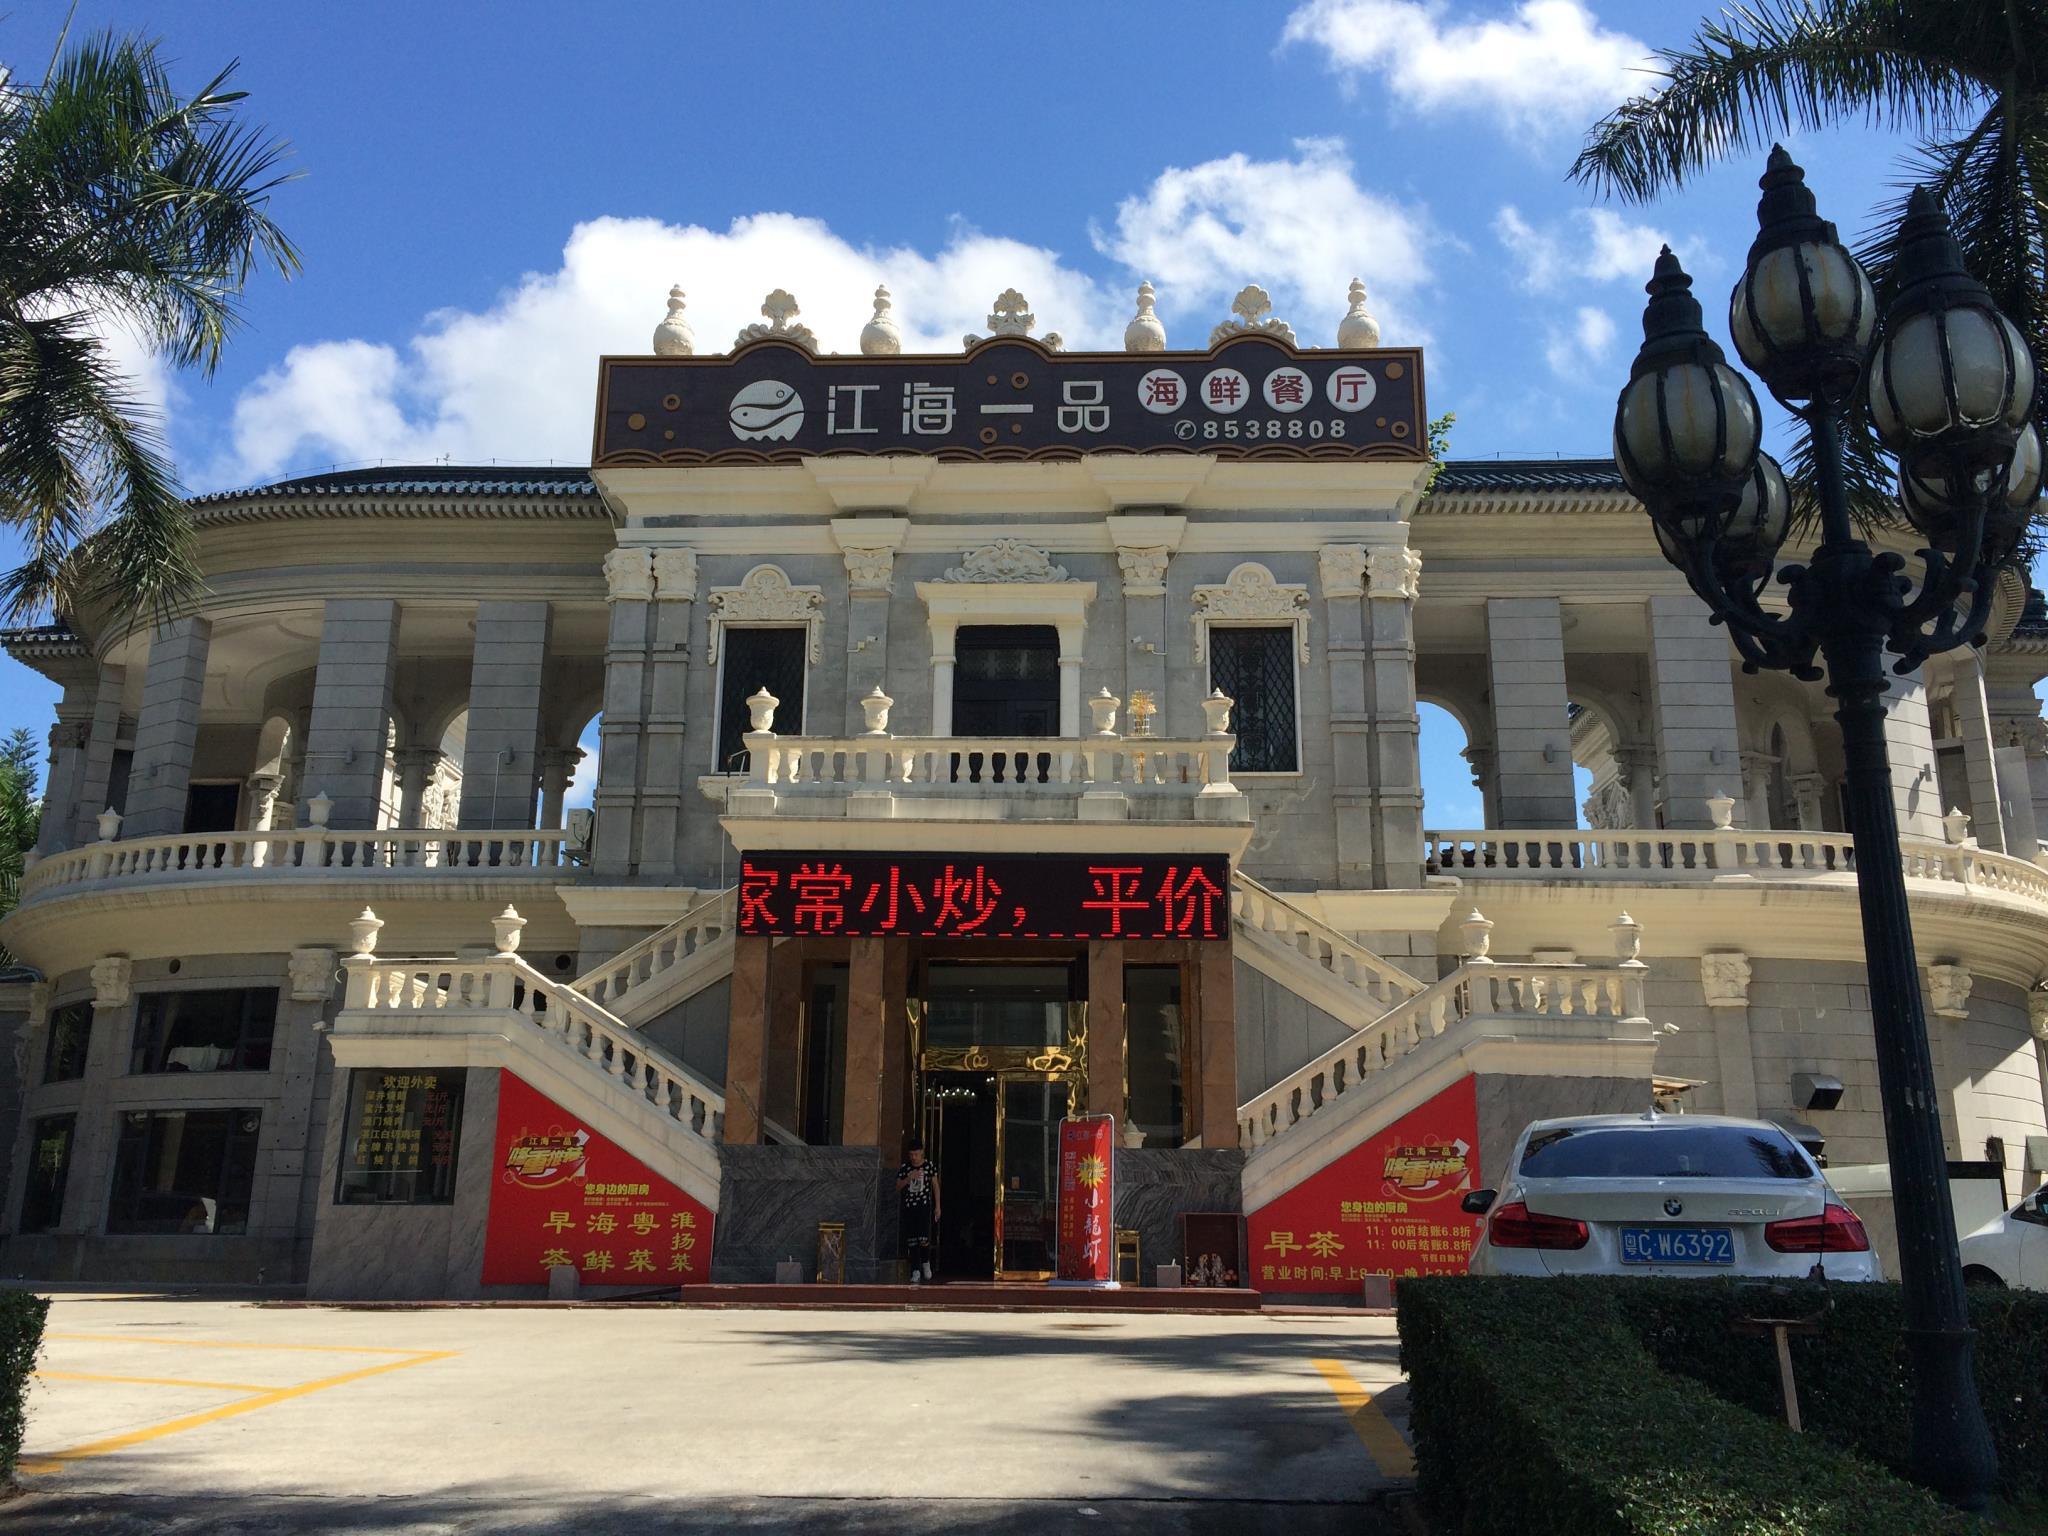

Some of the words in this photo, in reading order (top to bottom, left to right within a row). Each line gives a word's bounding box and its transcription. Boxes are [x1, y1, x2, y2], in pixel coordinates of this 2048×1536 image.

[1143, 371, 1372, 411] 海鲜餐厅
[826, 380, 1111, 435] 江海一品
[1203, 420, 1347, 439] 8538808
[383, 1076, 437, 1089] 欢迎外卖
[528, 1136, 572, 1146] 江海一品
[1405, 1147, 1451, 1156] 江海一品
[584, 1184, 650, 1196] 您身边的厨房
[1341, 1201, 1408, 1214] 您身边的厨房
[582, 1212, 618, 1273] 海鲜
[623, 1212, 660, 1272] 粤菜
[668, 1211, 696, 1272] 淮扬菜
[1263, 1231, 1345, 1258] 早茶
